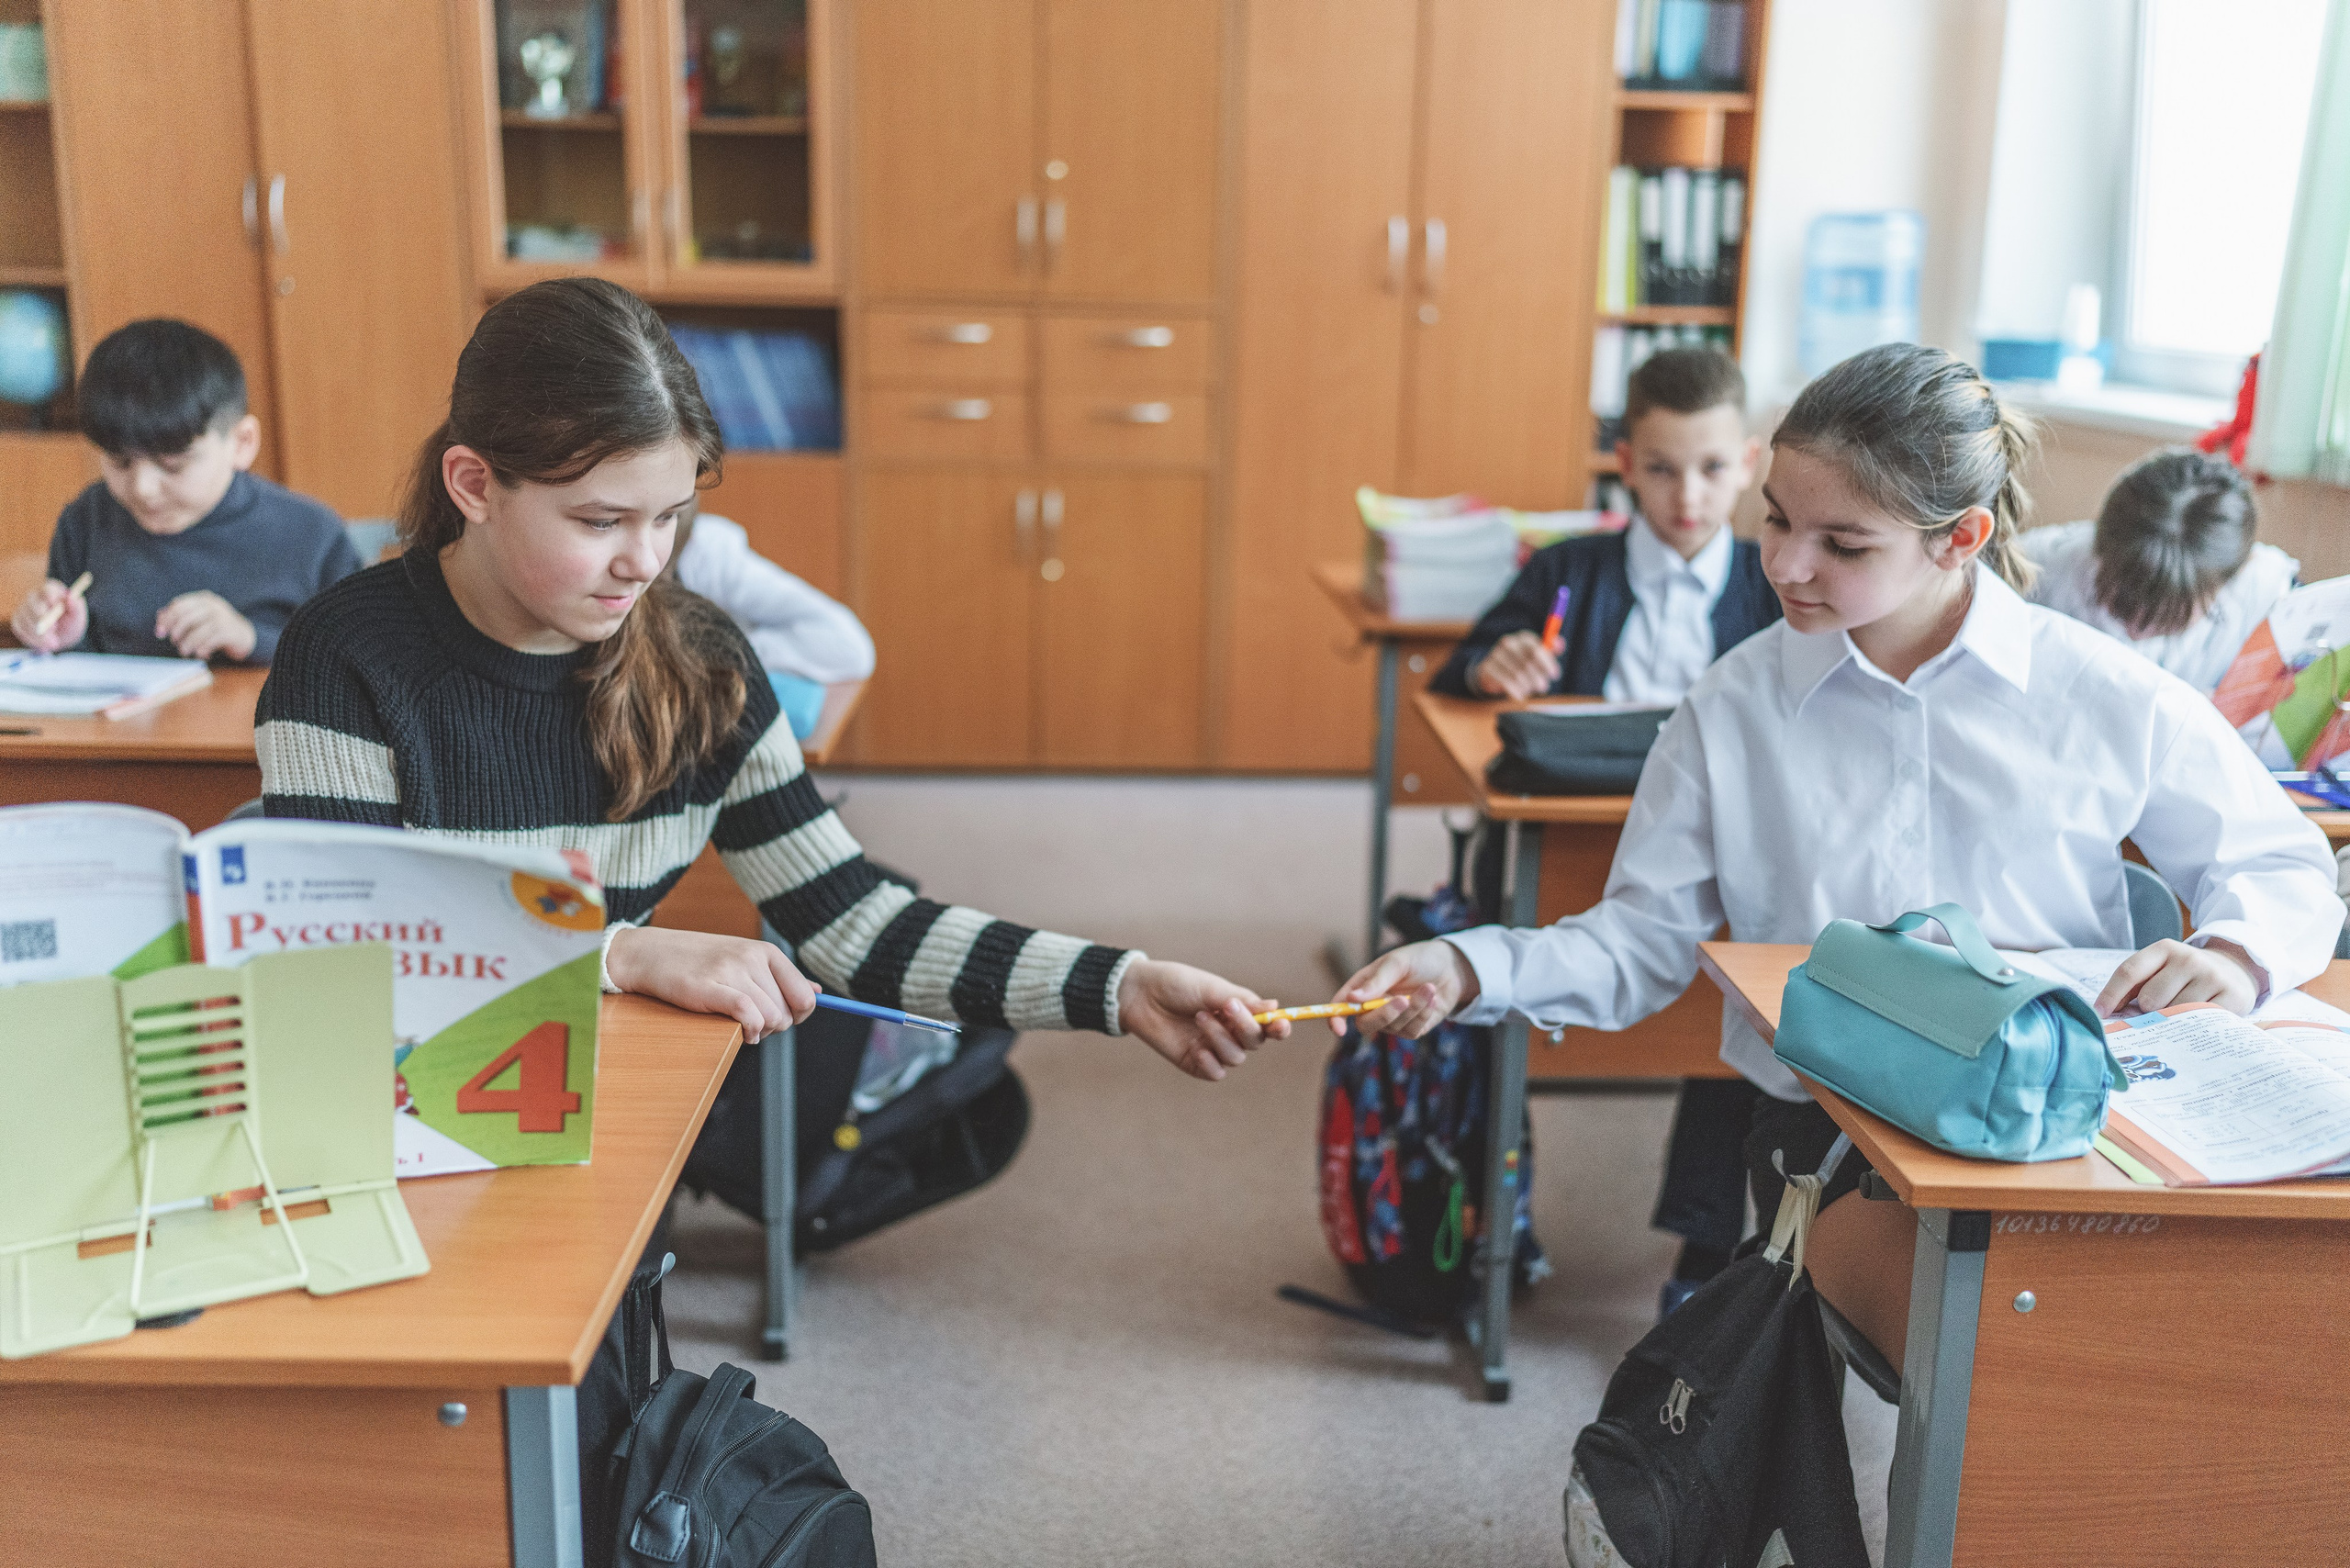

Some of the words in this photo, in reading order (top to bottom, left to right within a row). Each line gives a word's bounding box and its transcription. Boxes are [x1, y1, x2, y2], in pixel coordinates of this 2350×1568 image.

[227, 912, 444, 950] Русский
[397, 951, 507, 980] зык
[456, 1021, 582, 1134] 4
